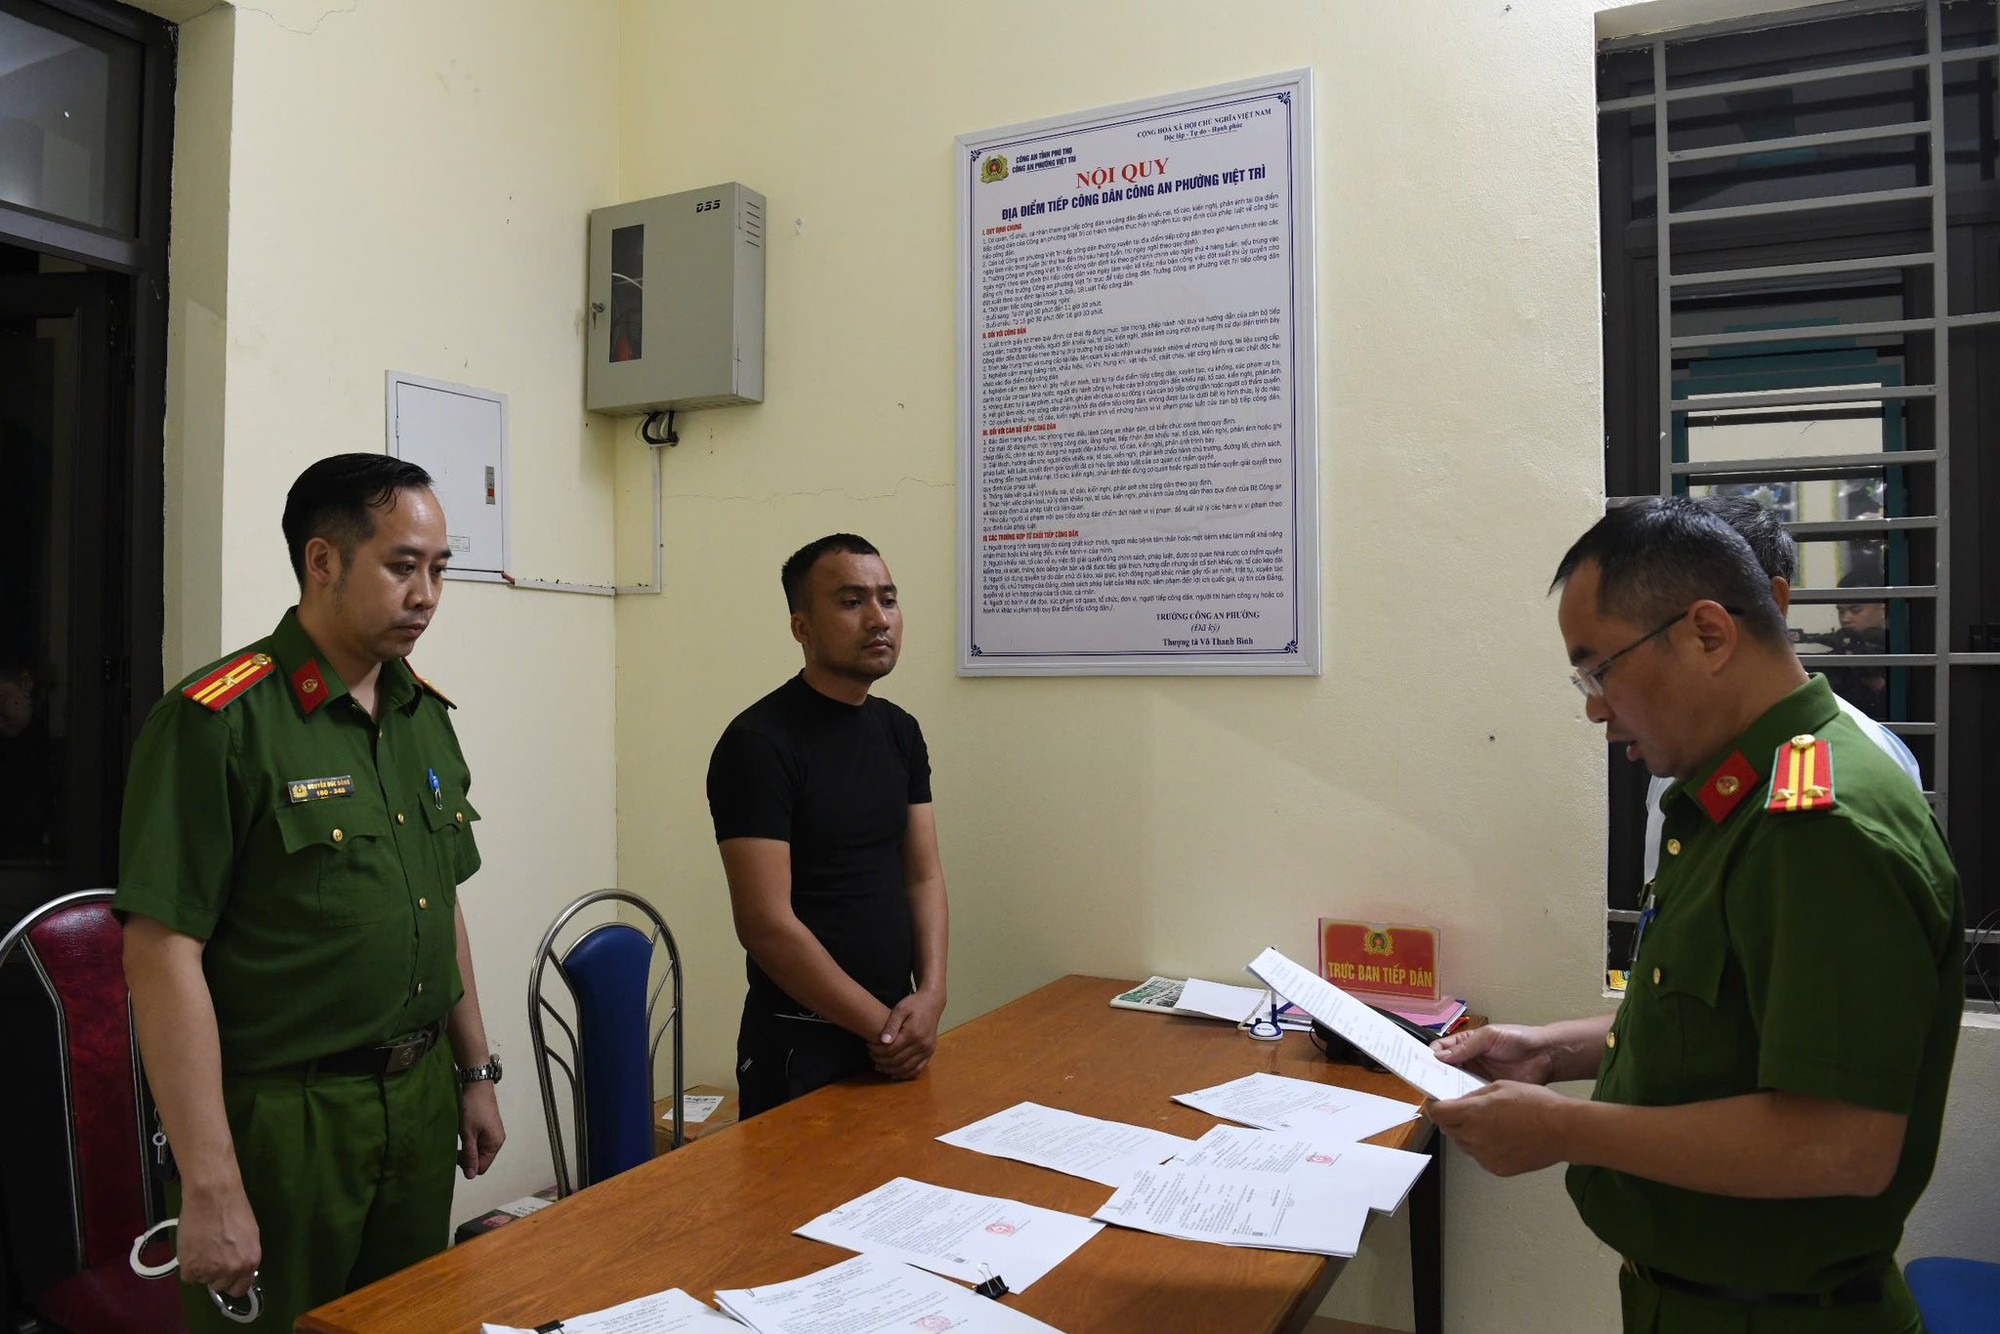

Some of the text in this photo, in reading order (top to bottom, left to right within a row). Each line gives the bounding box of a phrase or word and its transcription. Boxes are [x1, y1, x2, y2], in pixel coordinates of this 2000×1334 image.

[1012, 154, 1076, 174] CÔNG AN PHƯỜNG VIỆT TRÌ
[1016, 147, 1072, 163] CÔNG AN TỈNH PHÚ THỌ
[1076, 157, 1169, 189] NỘI QUY
[1001, 164, 1266, 222] ĐỊA ĐIỂM TIẾP CÔNG DÂN CÔNG AN PHƯỜNG VIỆT TRÌ
[696, 199, 721, 213] DSS
[1155, 608, 1260, 620] TRƯỞNG CÔNG AN PHƯỜNG
[1162, 636, 1253, 647] Thượng tá Võ Thanh Bình
[1328, 962, 1432, 987] TRỰC BAN TIẾP DÂN
